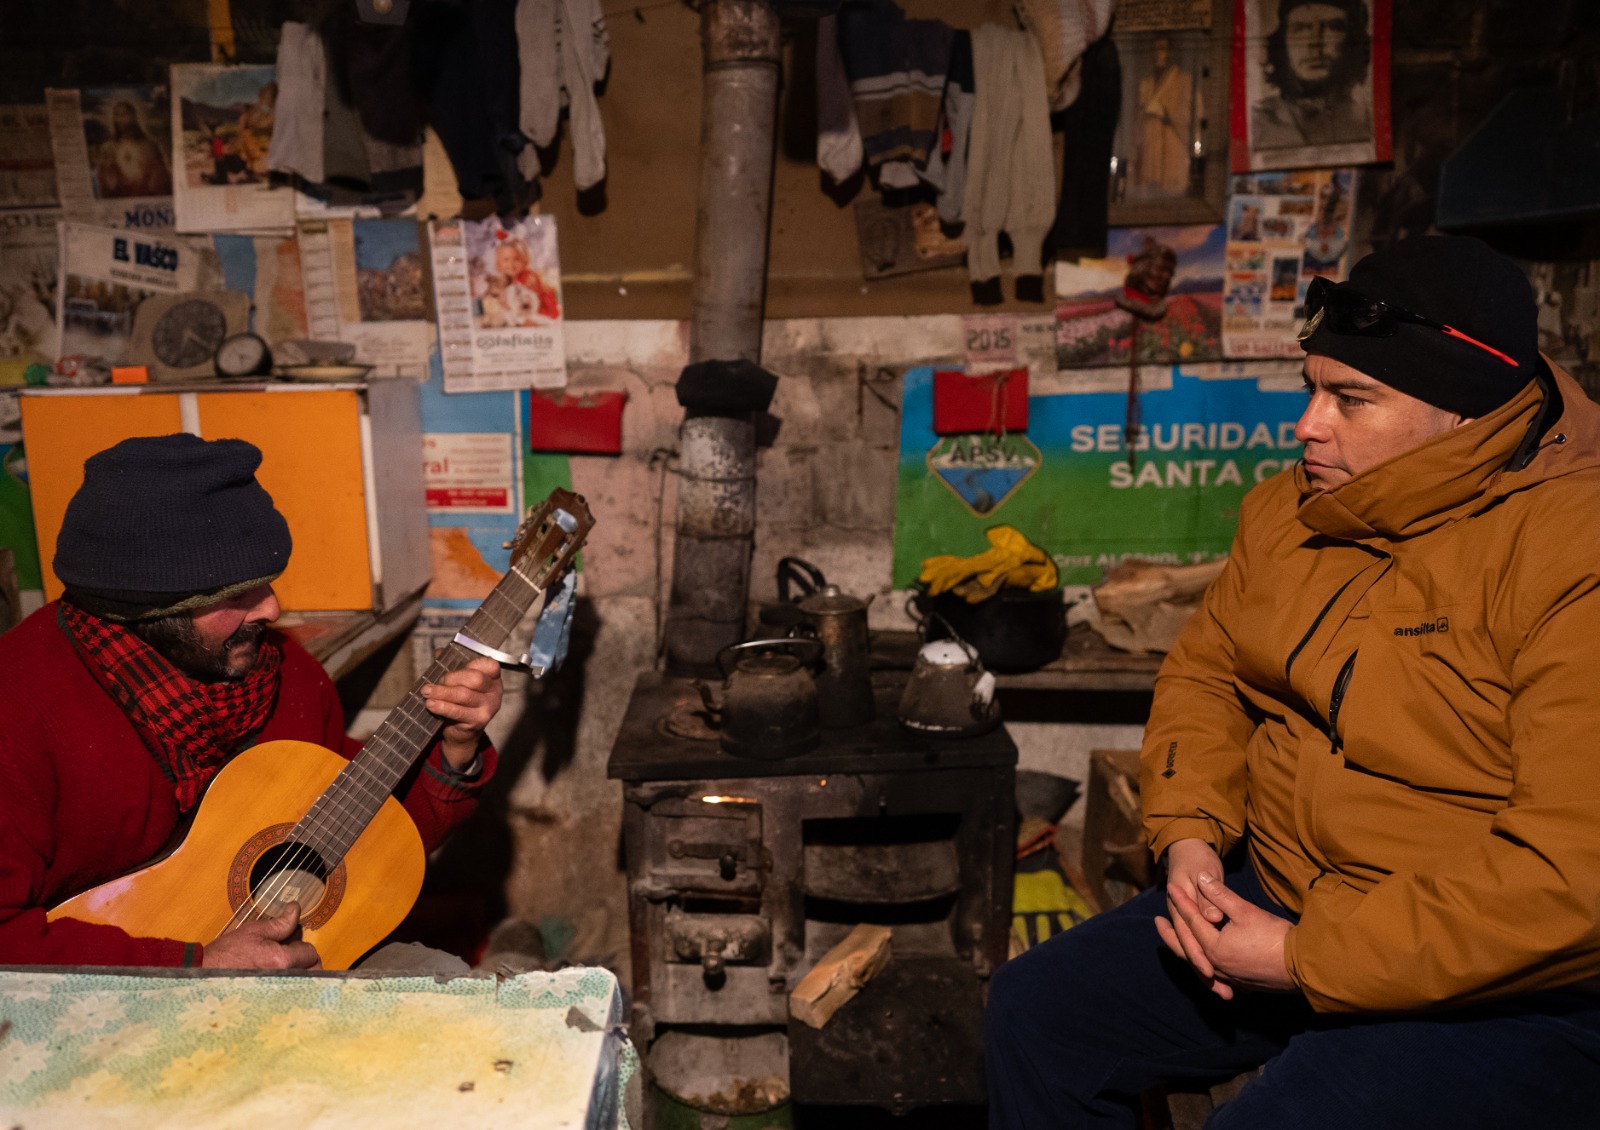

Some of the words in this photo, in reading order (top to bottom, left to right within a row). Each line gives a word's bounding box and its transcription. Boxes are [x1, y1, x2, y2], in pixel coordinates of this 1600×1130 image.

[113, 238, 129, 262] EL
[136, 243, 178, 271] VASCO
[1108, 459, 1243, 488] SANTA
